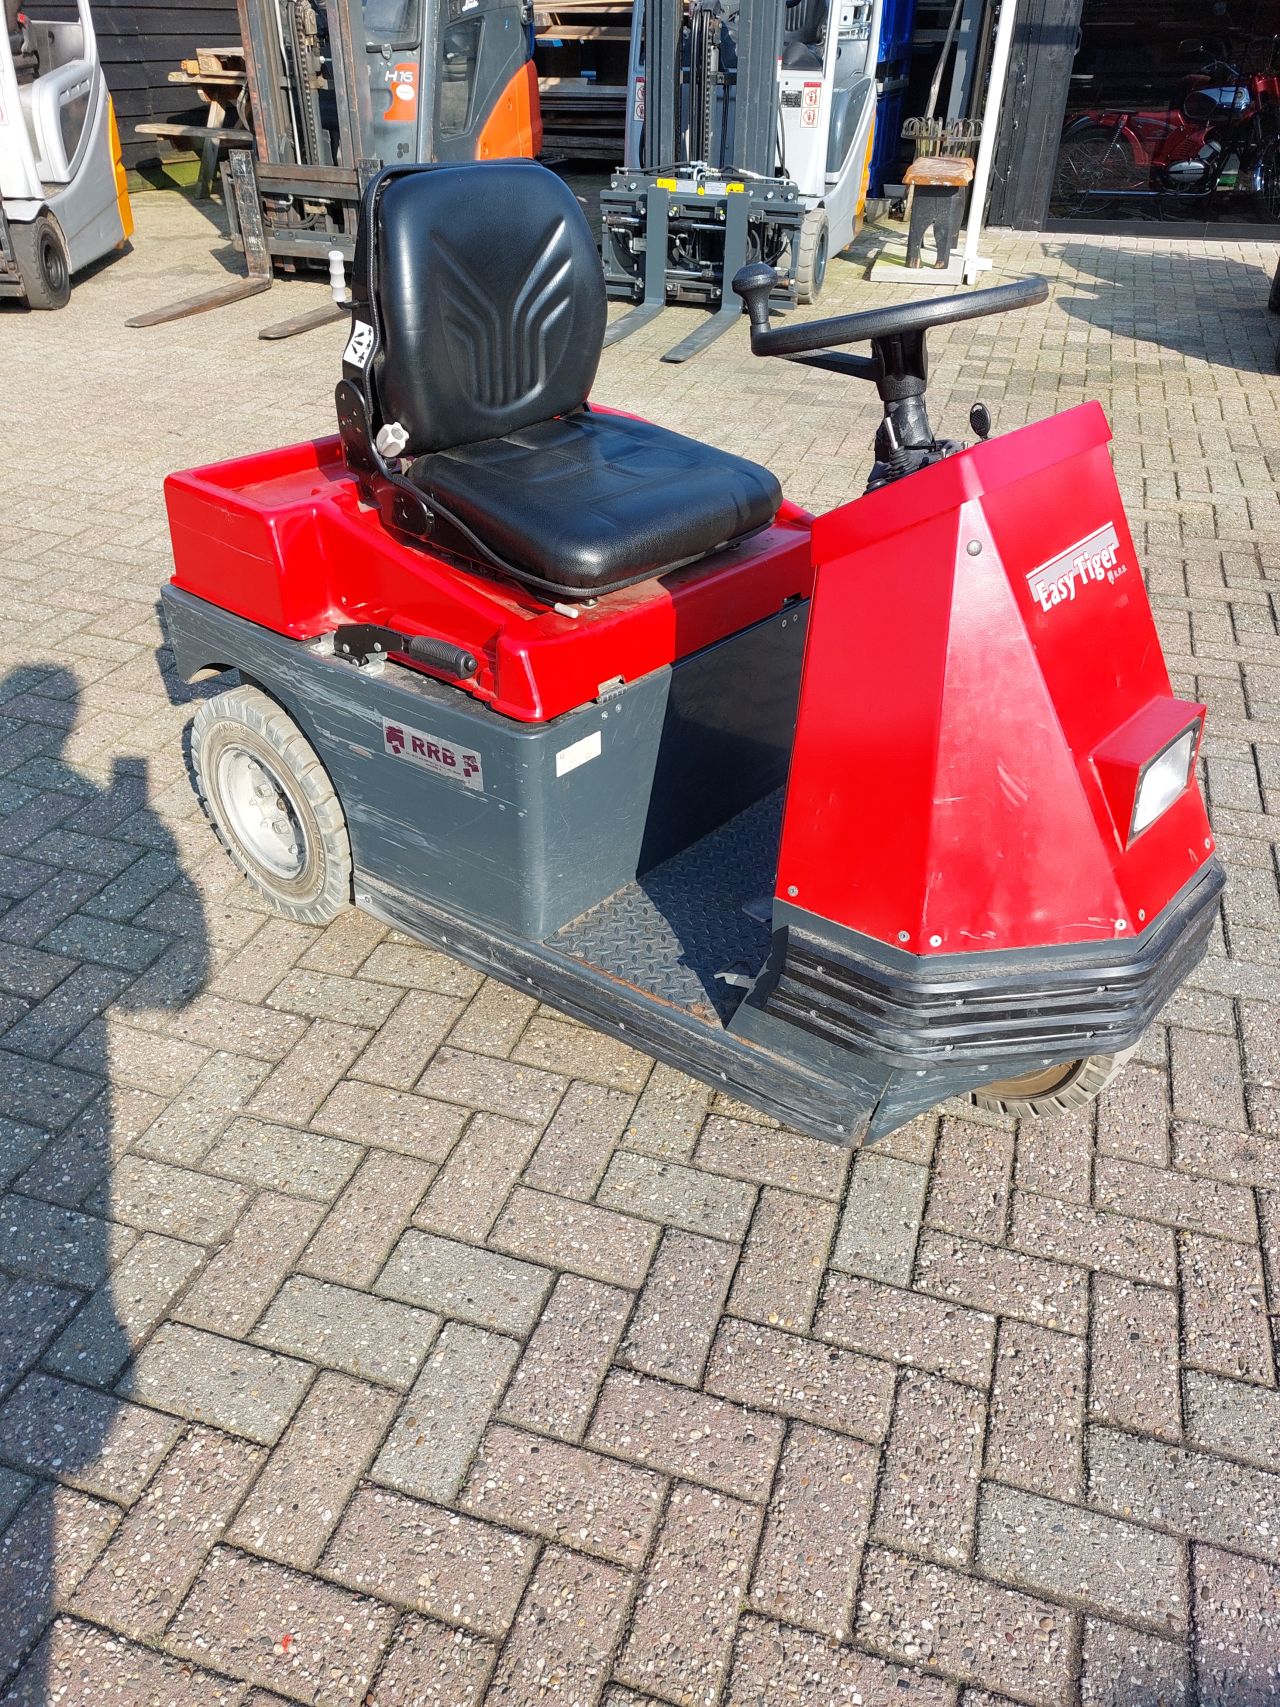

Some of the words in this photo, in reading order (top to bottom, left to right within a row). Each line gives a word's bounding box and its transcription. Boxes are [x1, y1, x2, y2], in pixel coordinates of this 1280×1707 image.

[1035, 570, 1076, 612] Easy
[1074, 543, 1117, 585] Tiger
[411, 735, 457, 767] RRB
